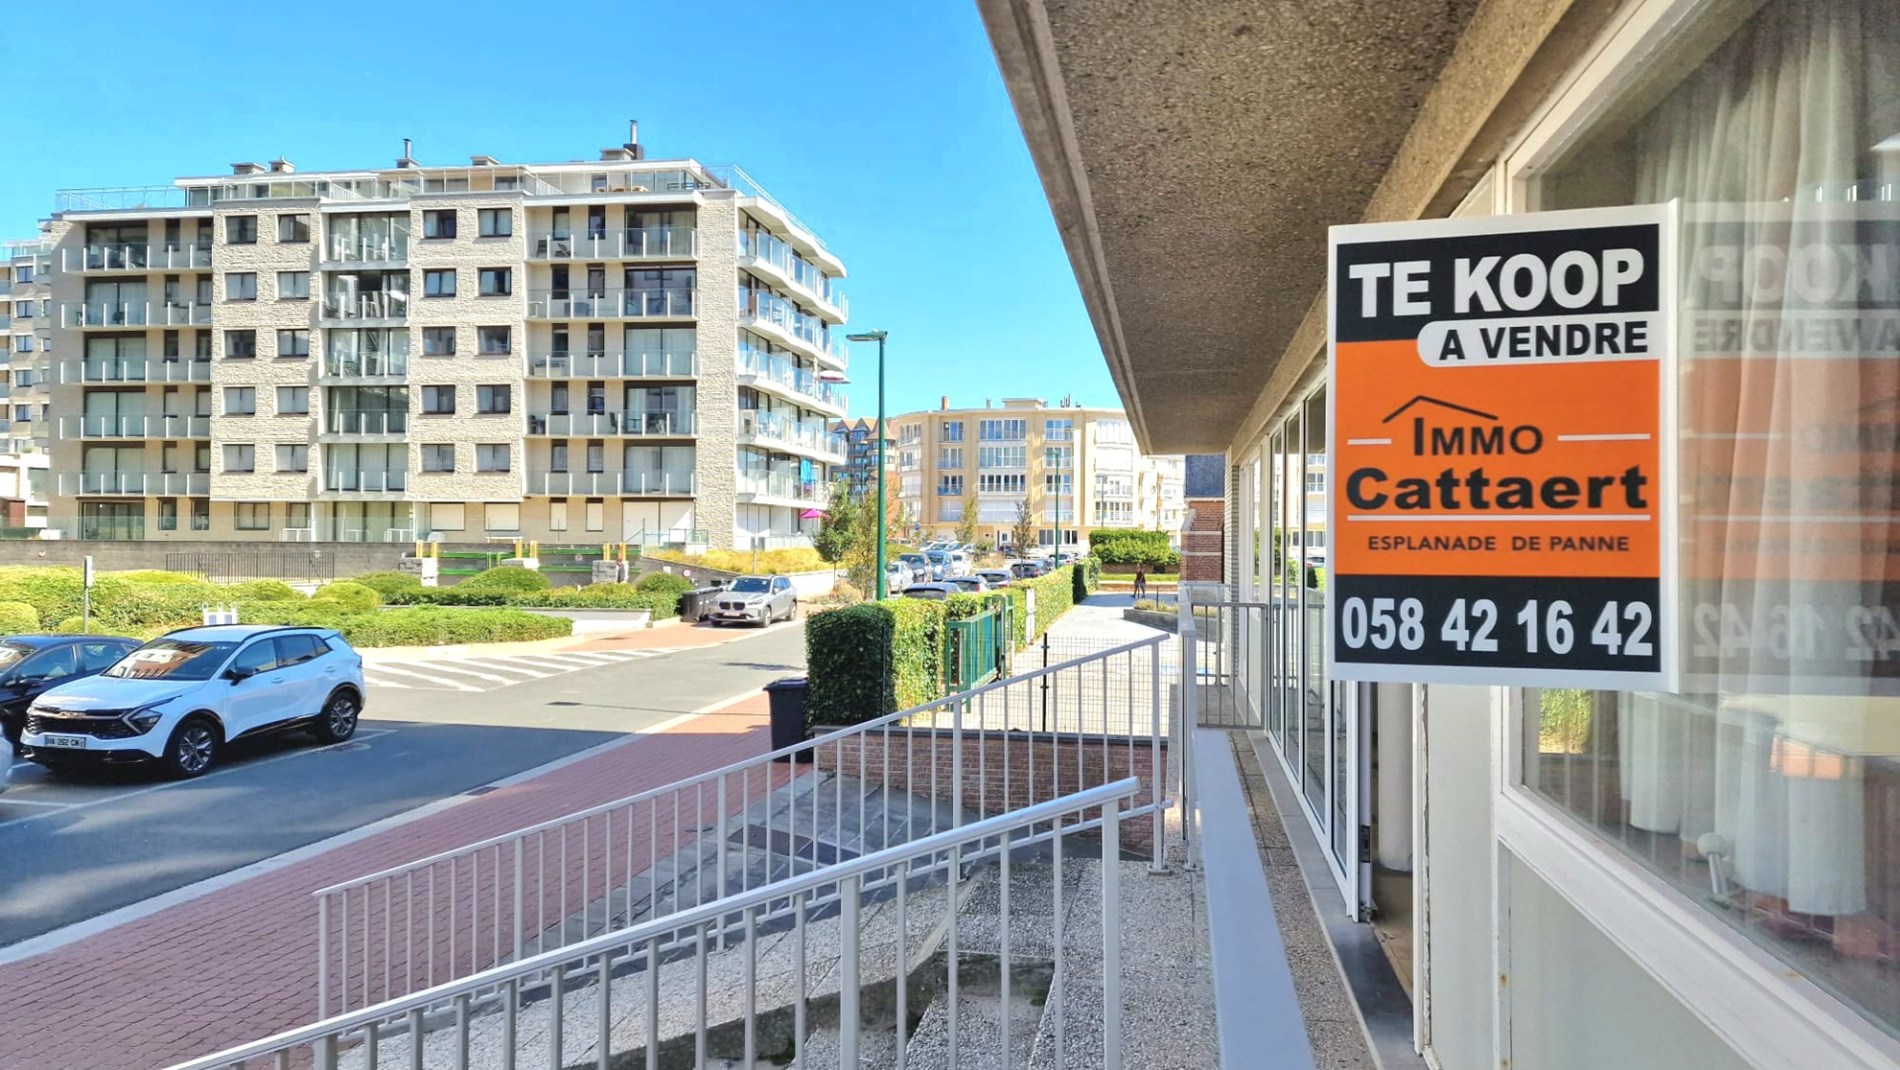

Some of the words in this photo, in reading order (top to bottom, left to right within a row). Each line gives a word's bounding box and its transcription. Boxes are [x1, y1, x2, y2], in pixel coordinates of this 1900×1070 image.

[1349, 260, 1432, 318] TE
[1454, 248, 1644, 314] KOOP
[1439, 329, 1466, 361] A
[1479, 320, 1649, 359] VENDRE
[1413, 417, 1544, 457] IMMO
[1345, 465, 1648, 511] Cattaert
[1368, 535, 1497, 551] ESPLANADE
[1512, 535, 1541, 551] DE
[1549, 536, 1630, 552] PANNE
[1342, 596, 1425, 651] 058
[1441, 598, 1499, 652] 42
[1517, 599, 1574, 655] 16
[1591, 600, 1653, 657] 42
